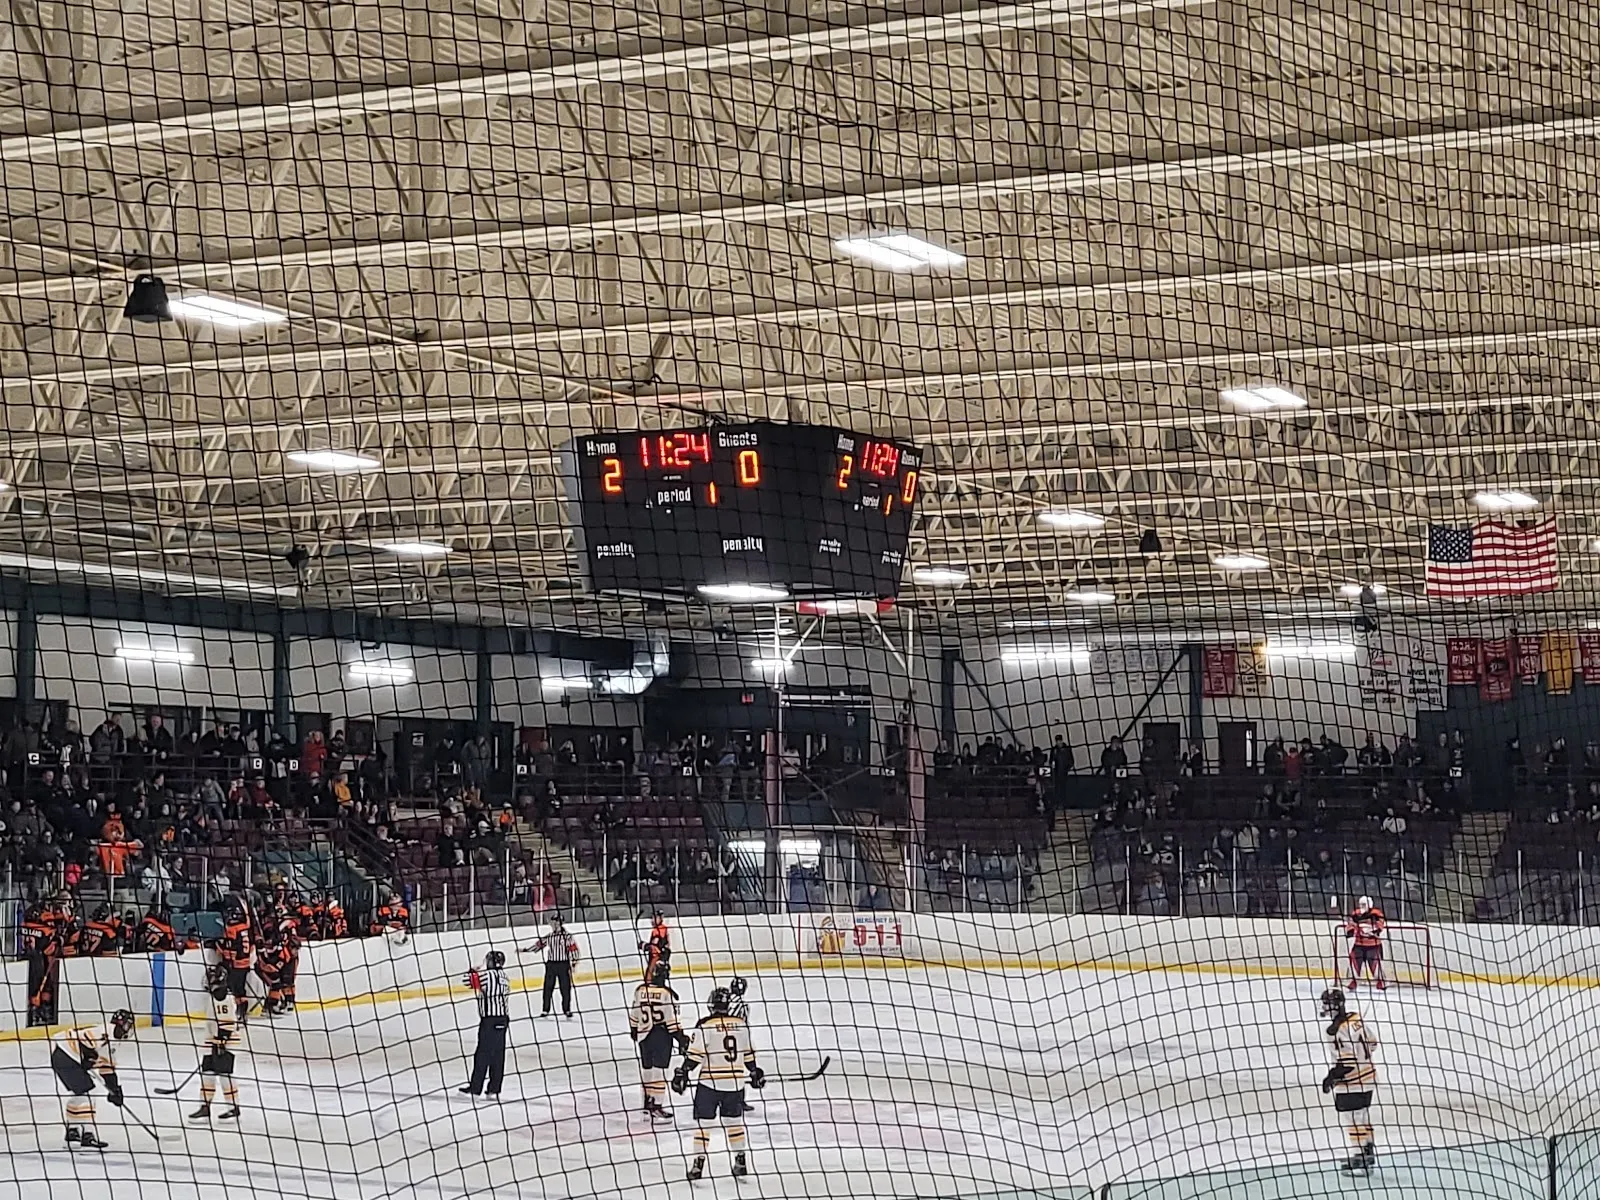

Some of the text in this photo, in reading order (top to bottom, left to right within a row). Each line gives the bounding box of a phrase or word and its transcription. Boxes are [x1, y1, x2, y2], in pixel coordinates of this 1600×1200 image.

[586, 441, 616, 456] Home
[641, 433, 709, 467] 11:24
[719, 432, 758, 447] Guests
[739, 450, 759, 484] 0
[863, 441, 899, 477] 11:24
[604, 459, 622, 492] 2
[839, 455, 852, 488] 2
[658, 487, 691, 505] period
[709, 481, 716, 505] 1
[903, 471, 917, 503] 0
[885, 494, 892, 516] 1
[723, 537, 763, 554] penalty
[853, 925, 902, 946] 9-1-1
[217, 1005, 228, 1014] 16
[640, 1001, 665, 1024] 55
[723, 1035, 738, 1063] 9
